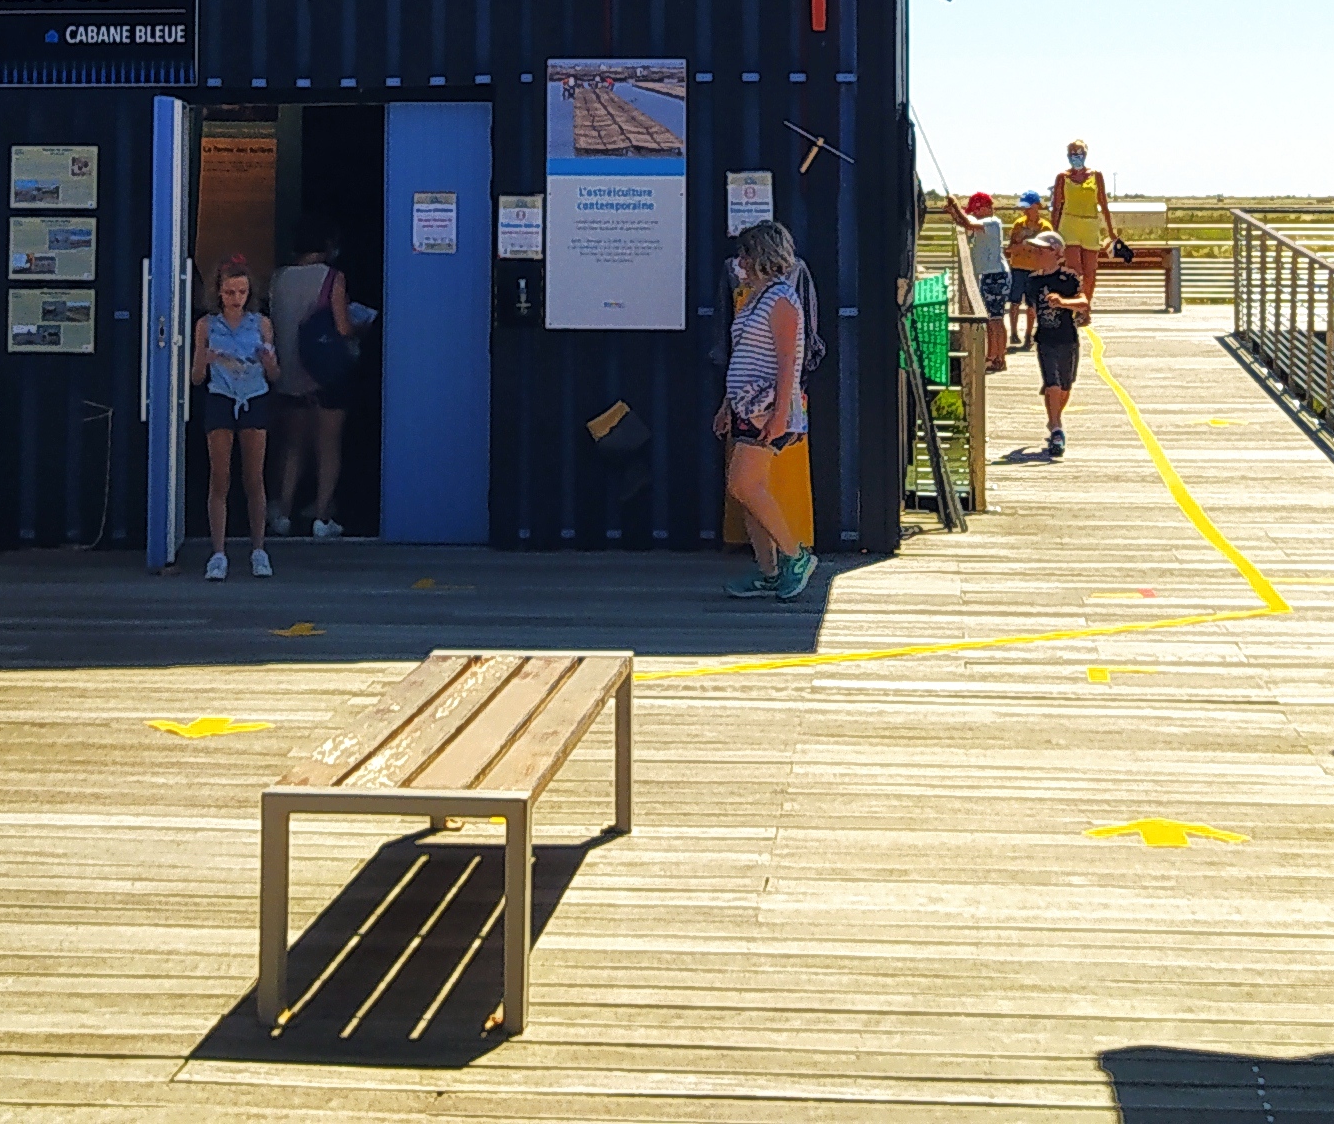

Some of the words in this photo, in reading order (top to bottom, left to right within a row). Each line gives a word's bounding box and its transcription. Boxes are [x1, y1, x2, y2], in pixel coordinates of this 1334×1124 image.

[65, 25, 131, 44] CABANE
[135, 24, 186, 44] BLEUE
[576, 201, 655, 212] contemporaine
